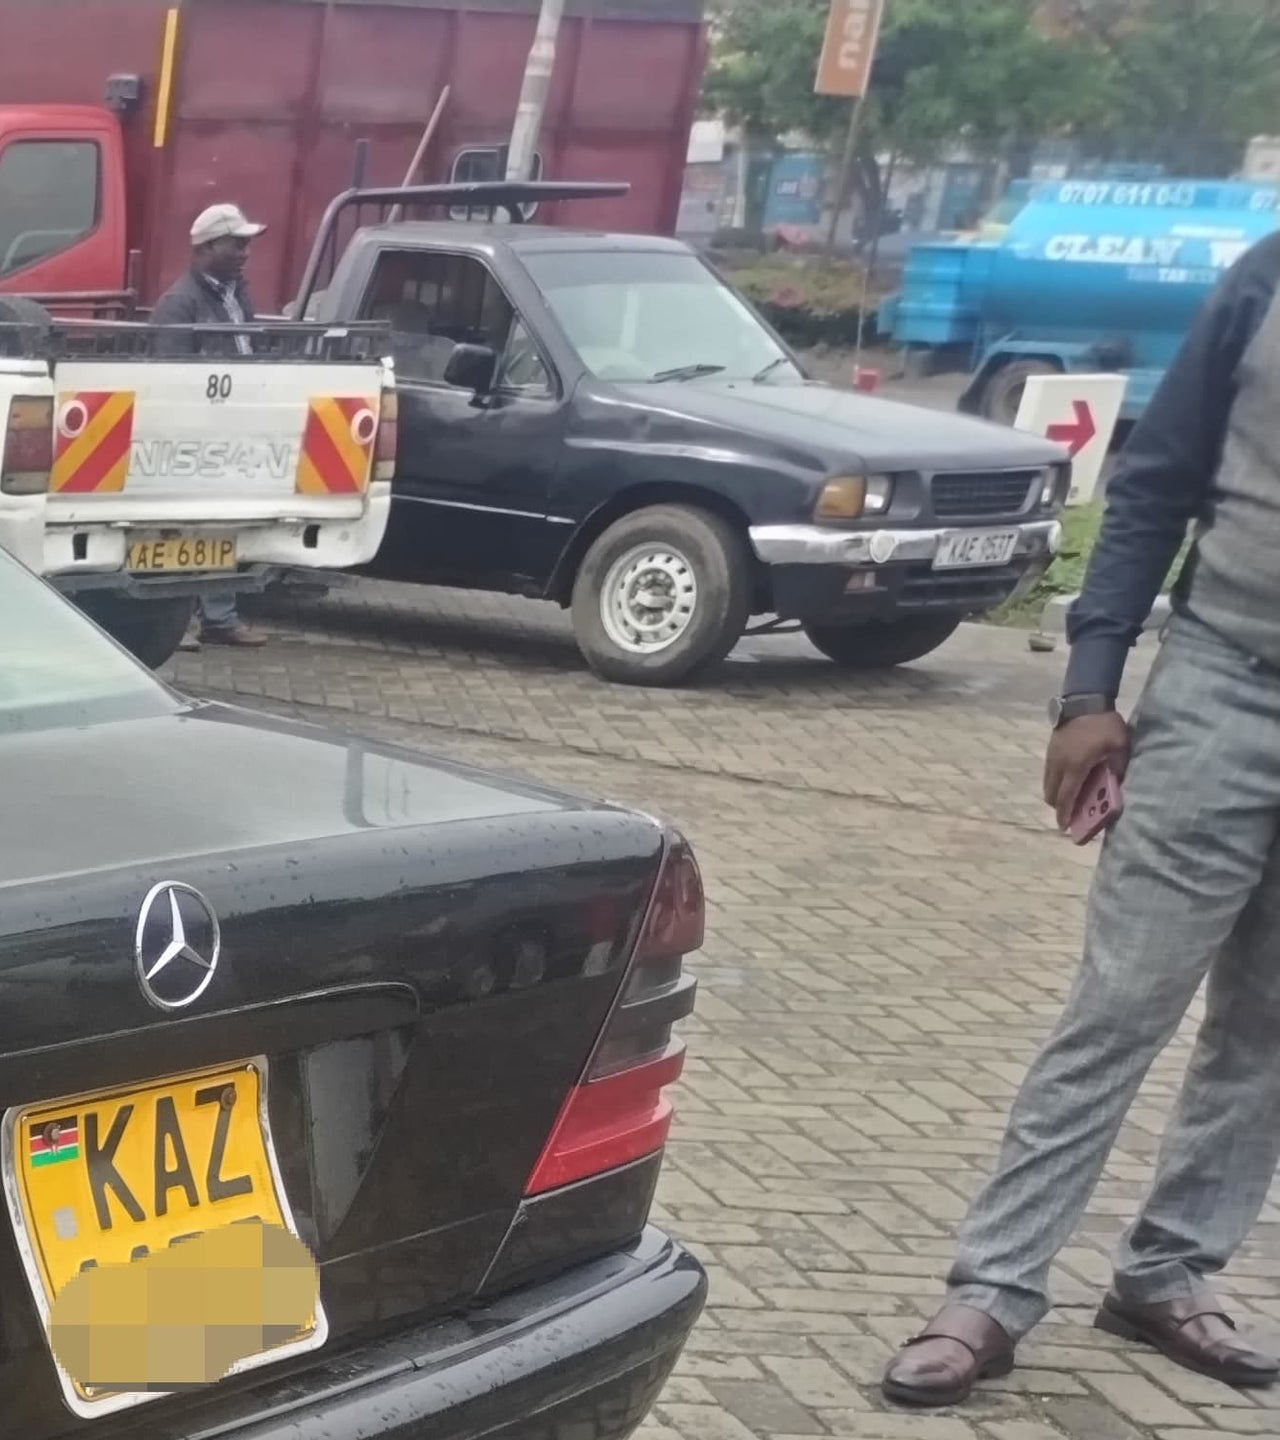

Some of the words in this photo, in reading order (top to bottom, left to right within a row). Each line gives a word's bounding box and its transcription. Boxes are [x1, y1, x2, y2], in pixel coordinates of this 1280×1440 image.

[1044, 234, 1184, 265] CLEAN
[206, 374, 233, 400] 80
[128, 439, 290, 480] NISSAN
[124, 542, 166, 569] KAE
[177, 539, 233, 566] 681P
[84, 1082, 253, 1231] KAZ
